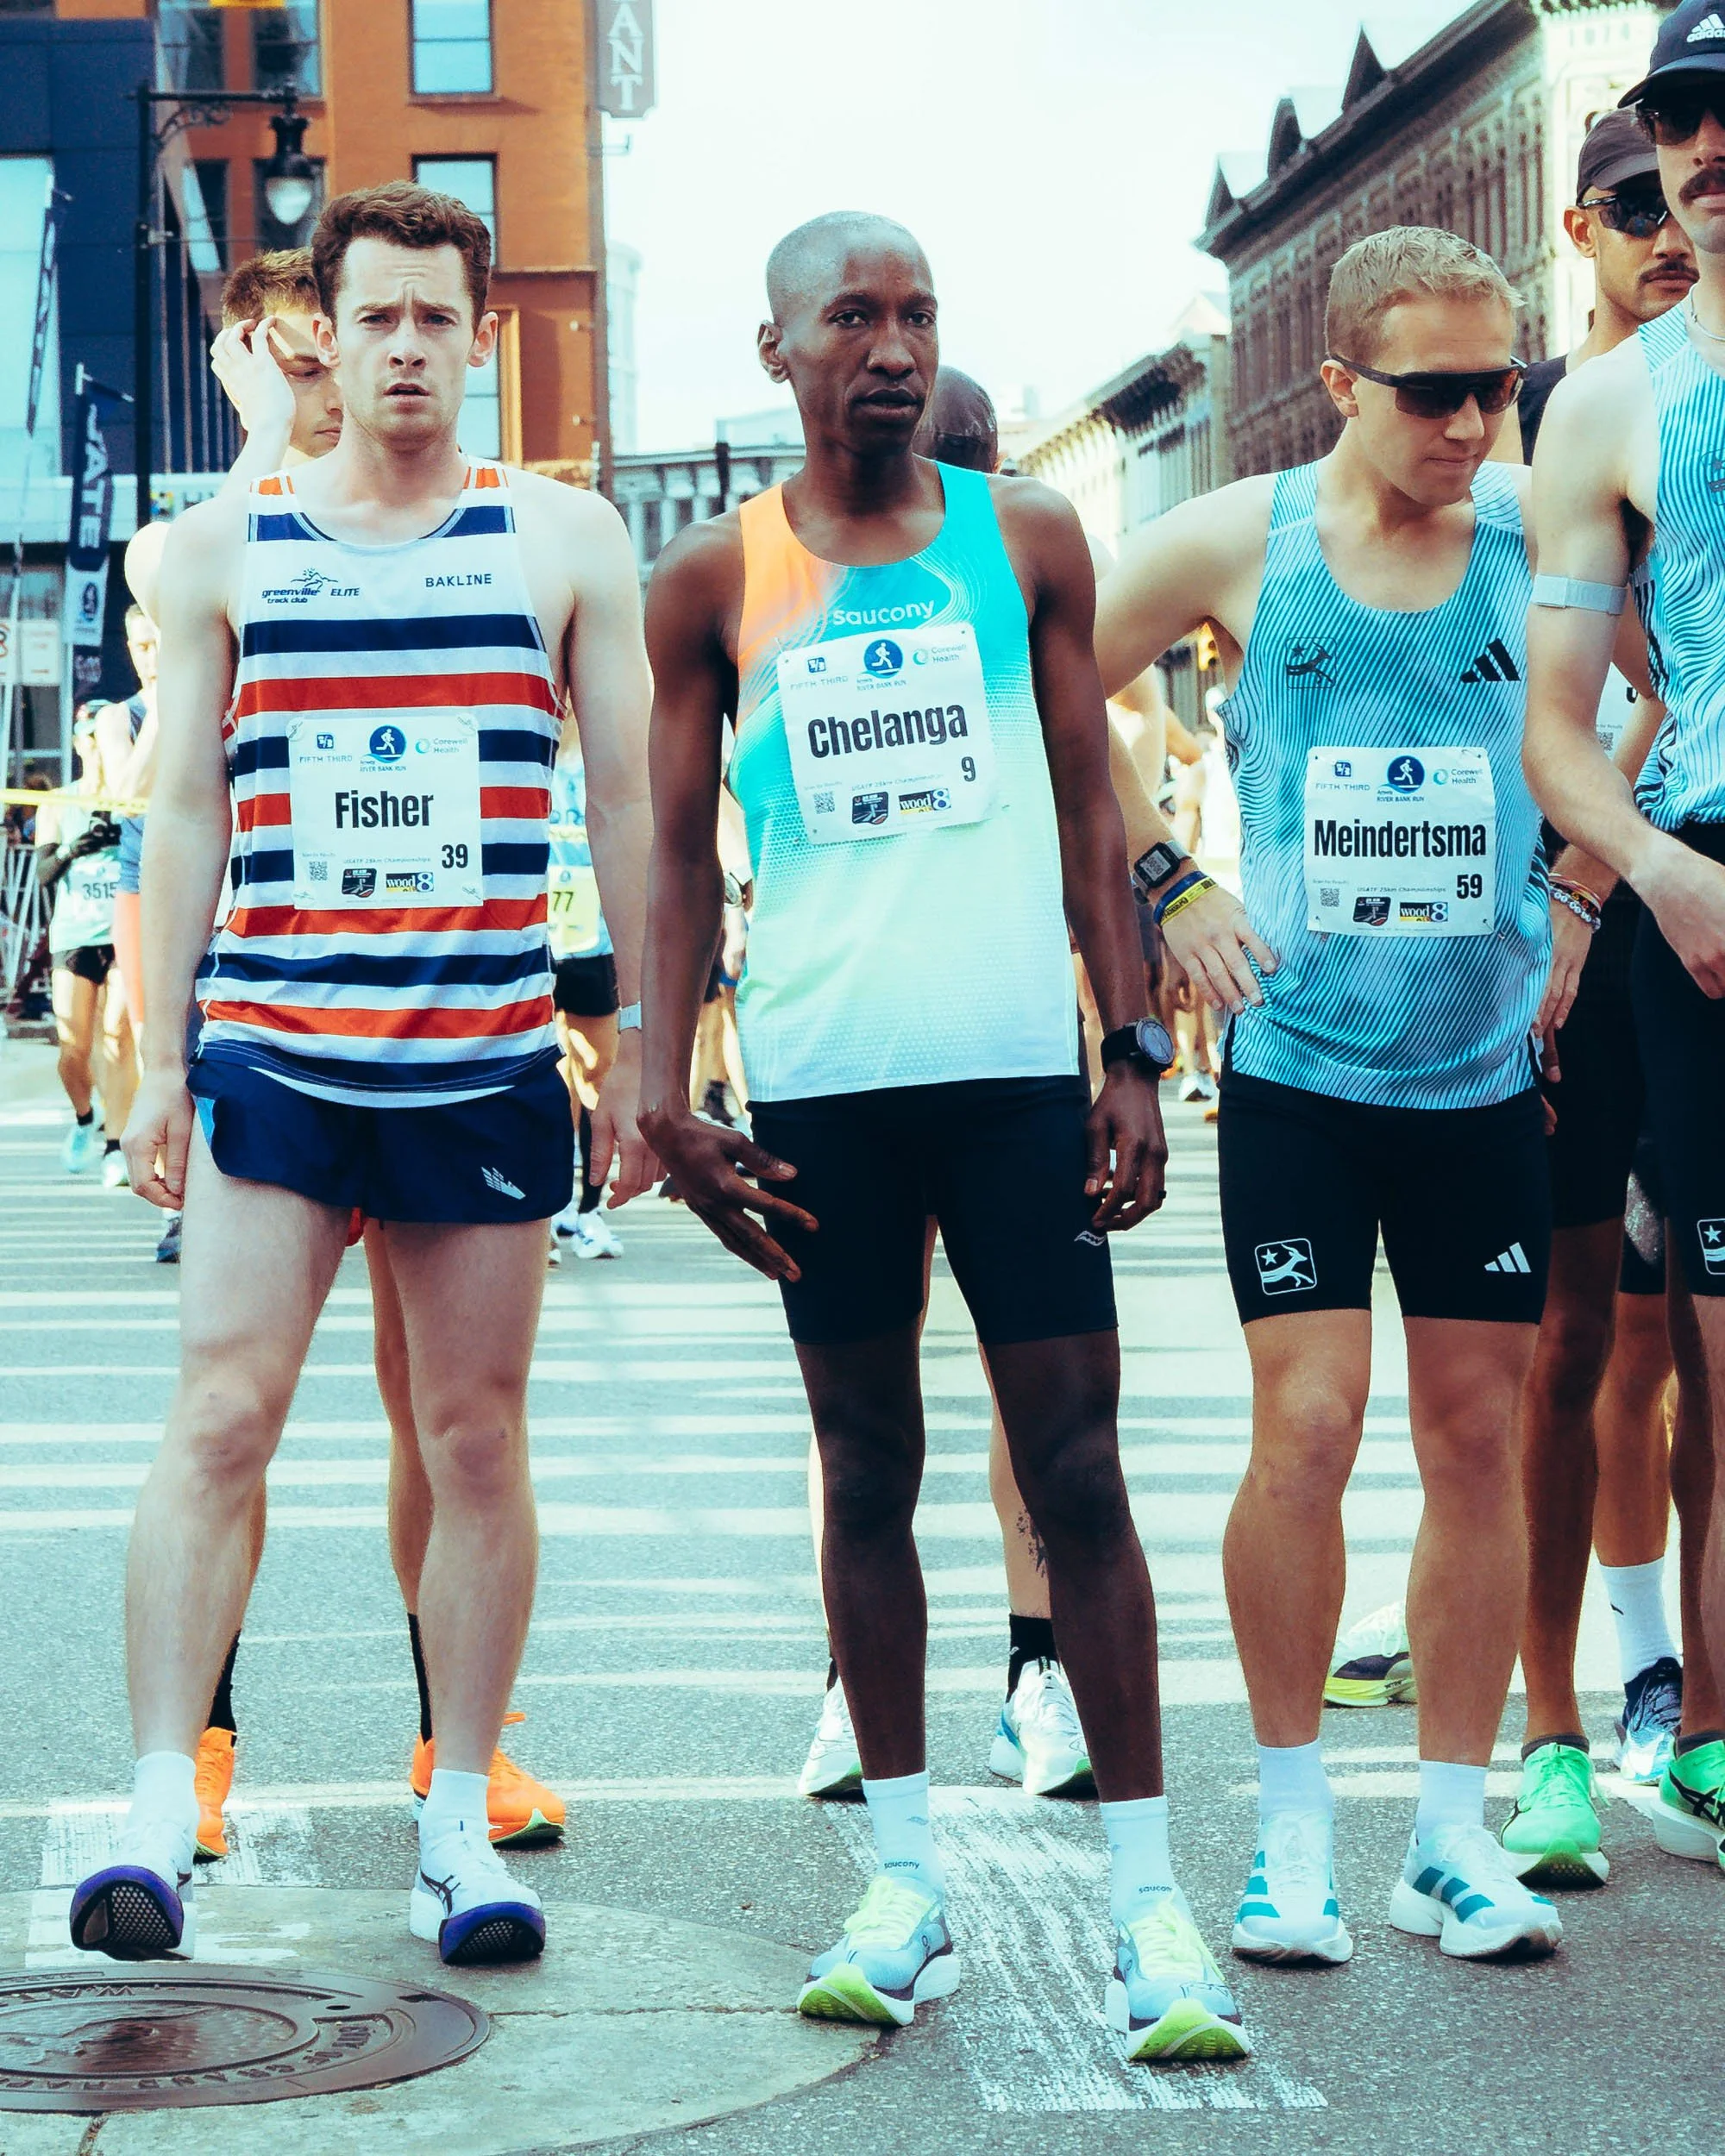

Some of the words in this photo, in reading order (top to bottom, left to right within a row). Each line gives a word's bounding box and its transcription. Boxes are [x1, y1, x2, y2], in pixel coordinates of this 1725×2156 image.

[1686, 28, 1725, 42] adida
[607, 2, 643, 110] ANT
[425, 573, 492, 587] BAKLINE
[261, 586, 320, 599] greenville
[330, 587, 361, 597] ELITE
[832, 600, 935, 626] saucony
[820, 675, 849, 686] THIRD
[807, 704, 969, 759] Chelanga
[961, 755, 976, 782] 9
[335, 790, 434, 829] Fisher
[900, 793, 932, 811] wood
[932, 788, 950, 811] 8
[1314, 818, 1487, 857] Meindertsma
[441, 843, 468, 869] 39
[386, 874, 415, 888] wood
[417, 872, 433, 893] 8
[1456, 874, 1483, 899] 59
[1401, 904, 1430, 917] wood
[1430, 902, 1448, 922] 8
[884, 1861, 919, 1870] saucony
